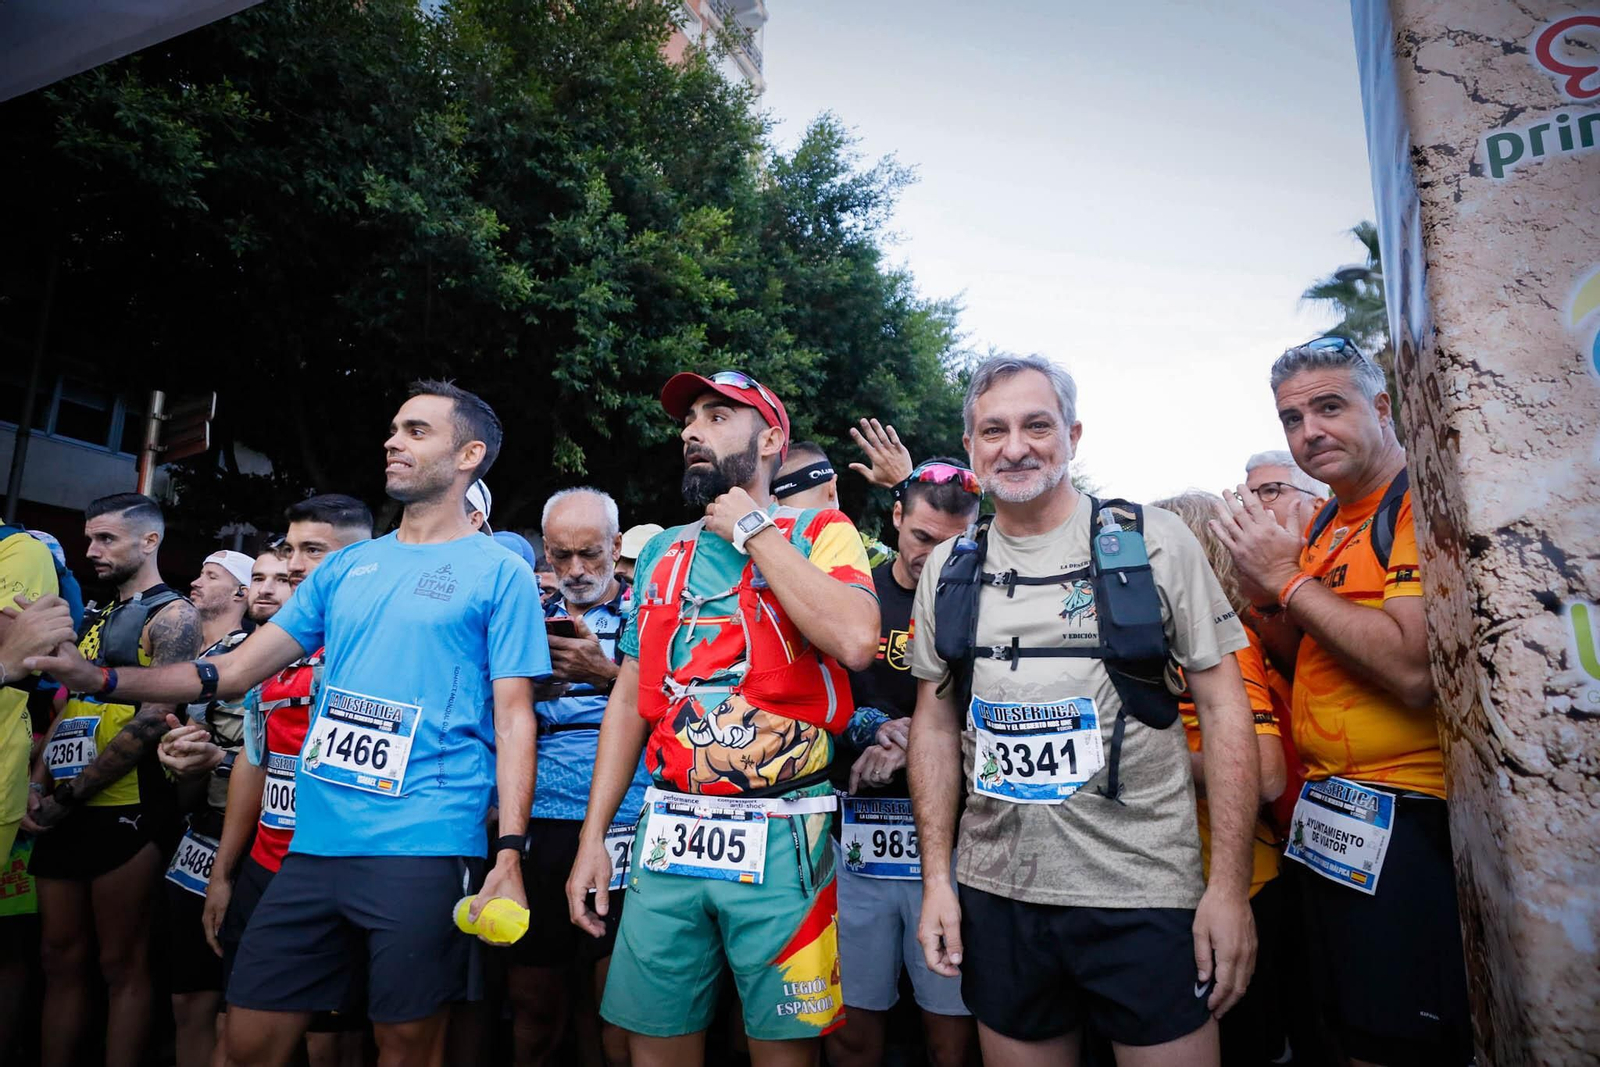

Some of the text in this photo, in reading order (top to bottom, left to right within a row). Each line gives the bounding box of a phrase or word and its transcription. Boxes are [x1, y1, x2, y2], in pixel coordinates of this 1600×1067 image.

[418, 578, 456, 594] UTMB
[50, 741, 83, 766] 2361
[327, 727, 391, 770] 1466
[996, 738, 1077, 778] 3341
[672, 823, 747, 863] 3405
[872, 829, 921, 859] 985
[1306, 817, 1364, 848] AYUNTAMIENTO
[1312, 831, 1348, 855] DE VIATOR
[180, 844, 215, 878] 3488
[614, 840, 635, 869] 2
[783, 975, 827, 997] LEGIÓN
